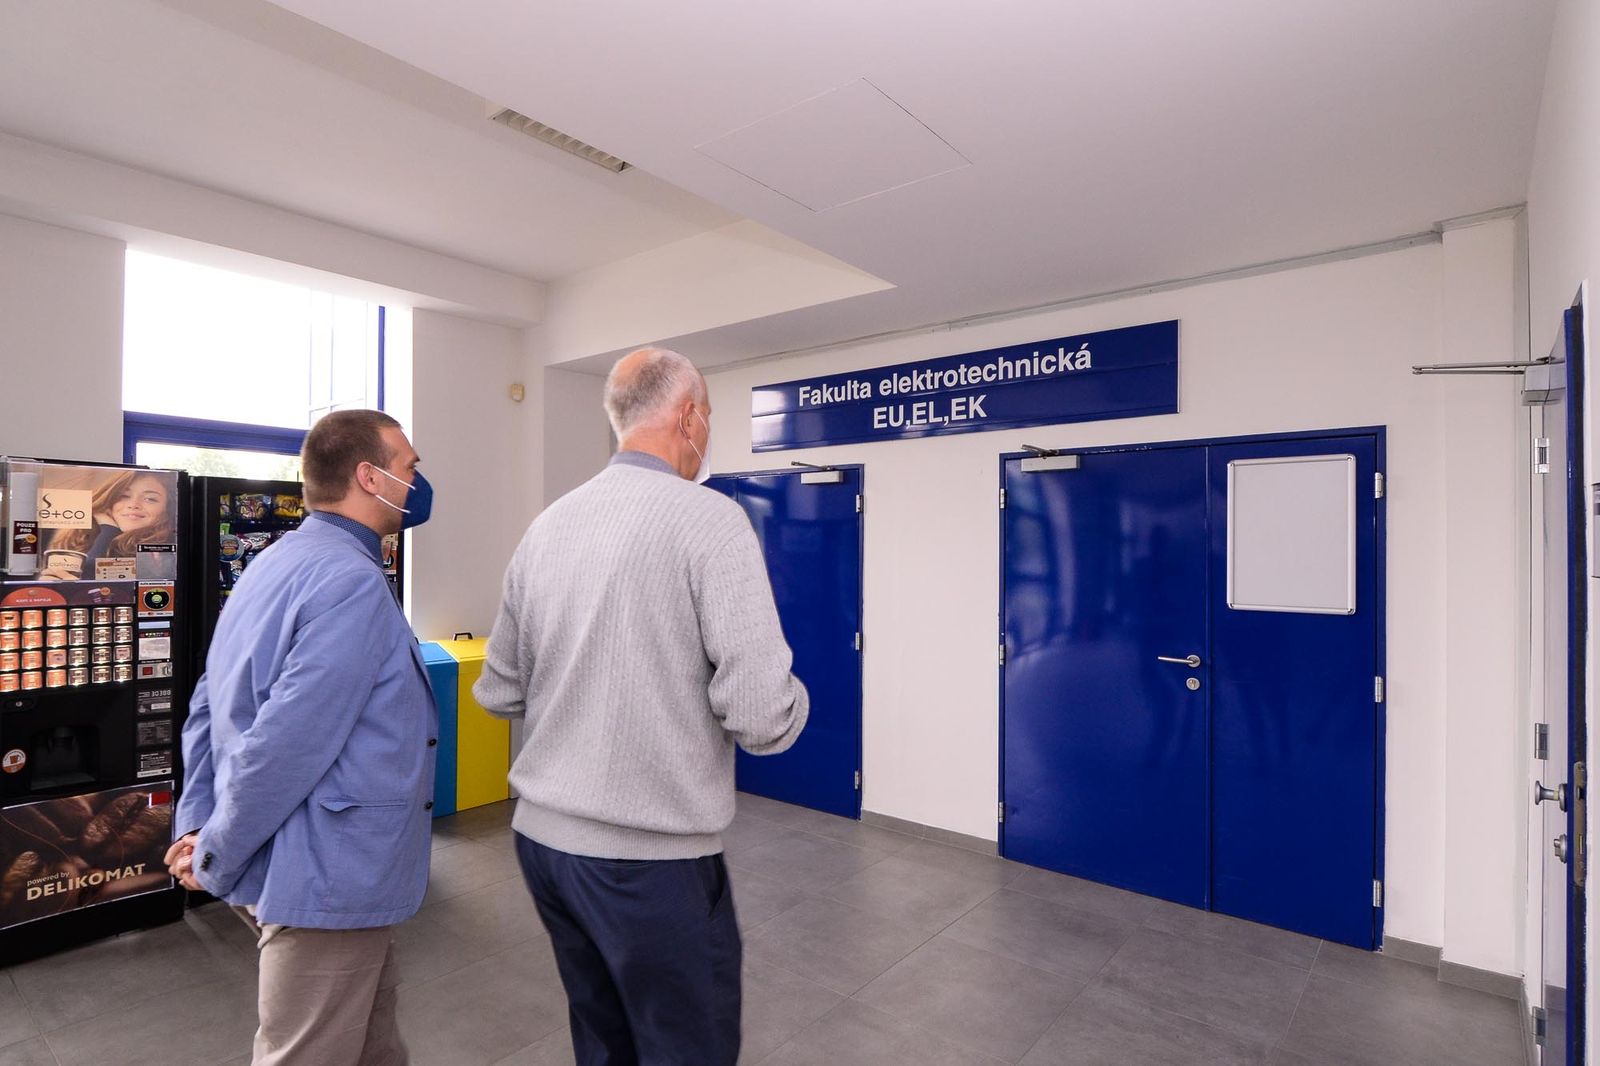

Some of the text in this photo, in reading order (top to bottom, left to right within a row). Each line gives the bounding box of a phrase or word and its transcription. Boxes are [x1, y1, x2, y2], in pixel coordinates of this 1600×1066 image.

[799, 343, 1092, 407] Fakulta elektrotechnická
[873, 395, 988, 429] EU,EL,EK
[27, 871, 70, 886] powered by
[27, 863, 146, 901] DELIKOMAT
